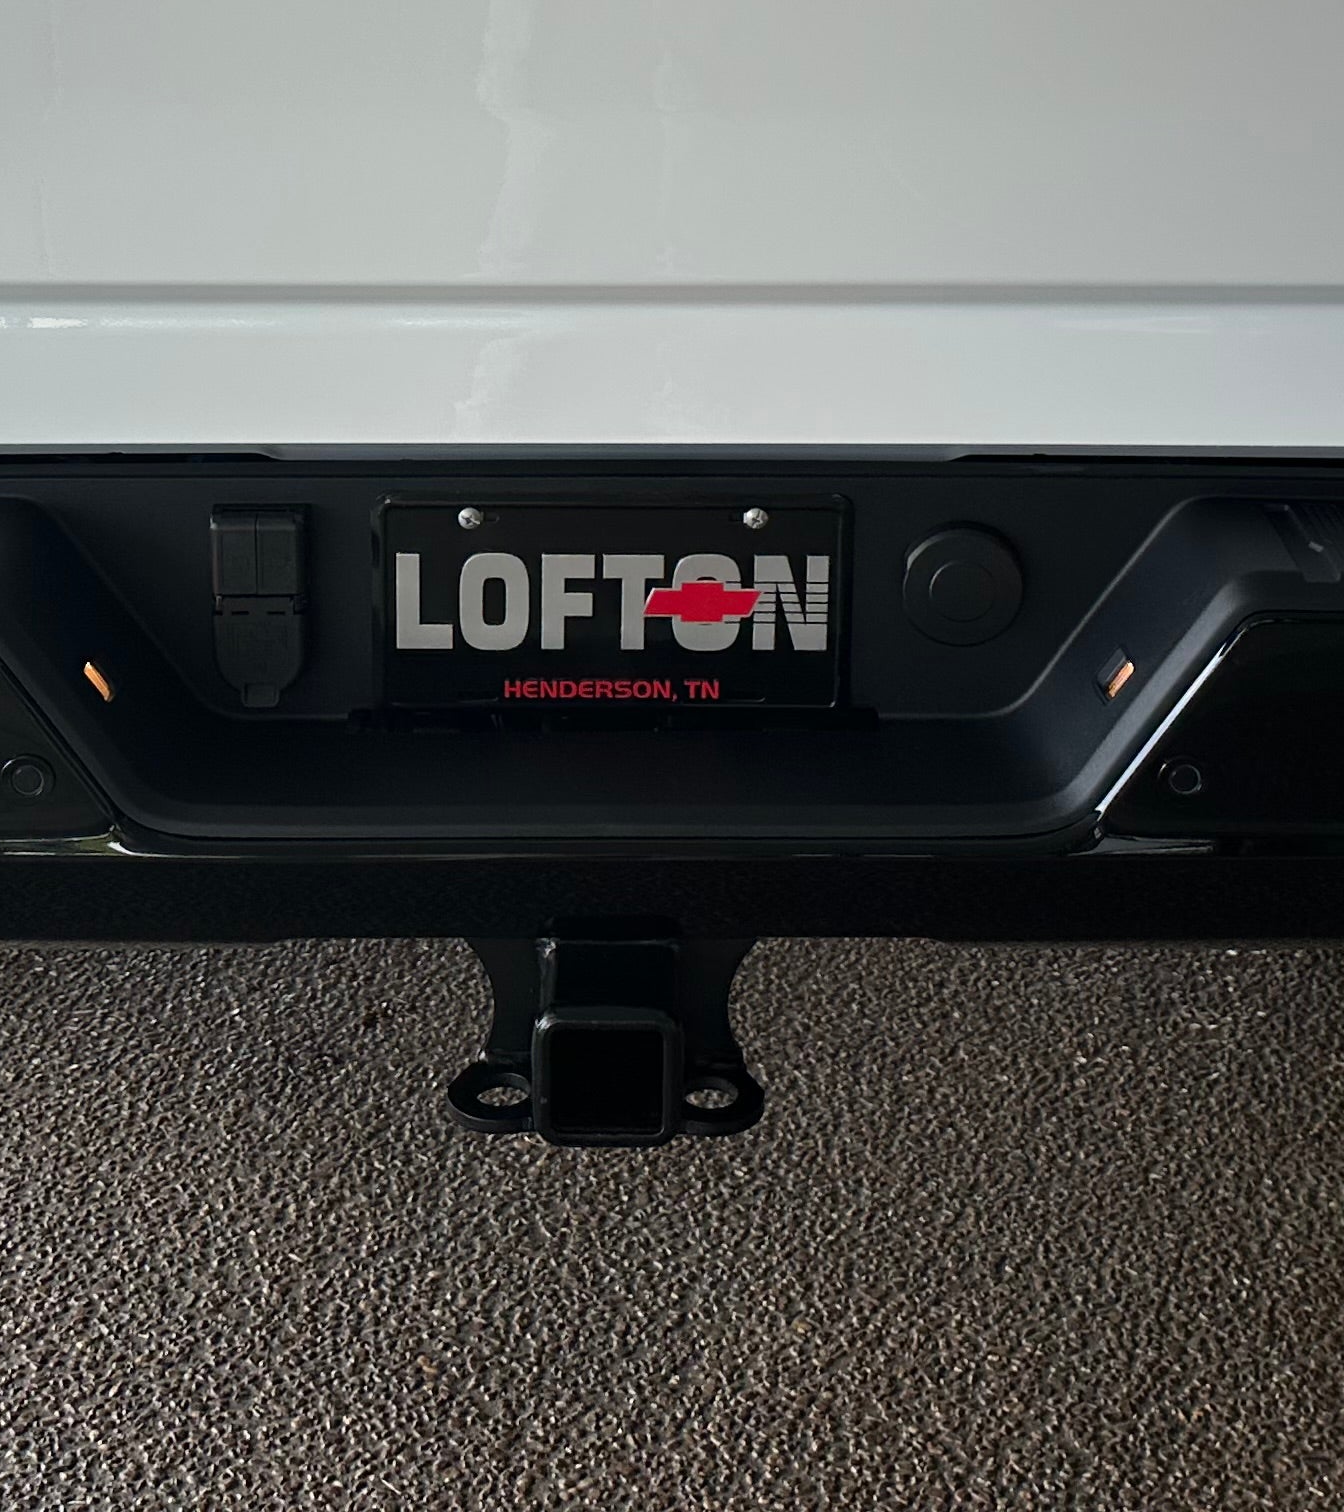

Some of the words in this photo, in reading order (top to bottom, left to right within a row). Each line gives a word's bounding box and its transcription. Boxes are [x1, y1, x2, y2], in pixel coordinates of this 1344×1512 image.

[395, 551, 830, 651] LOFTON
[503, 679, 678, 701] HENDERSON,
[684, 680, 720, 700] TN
